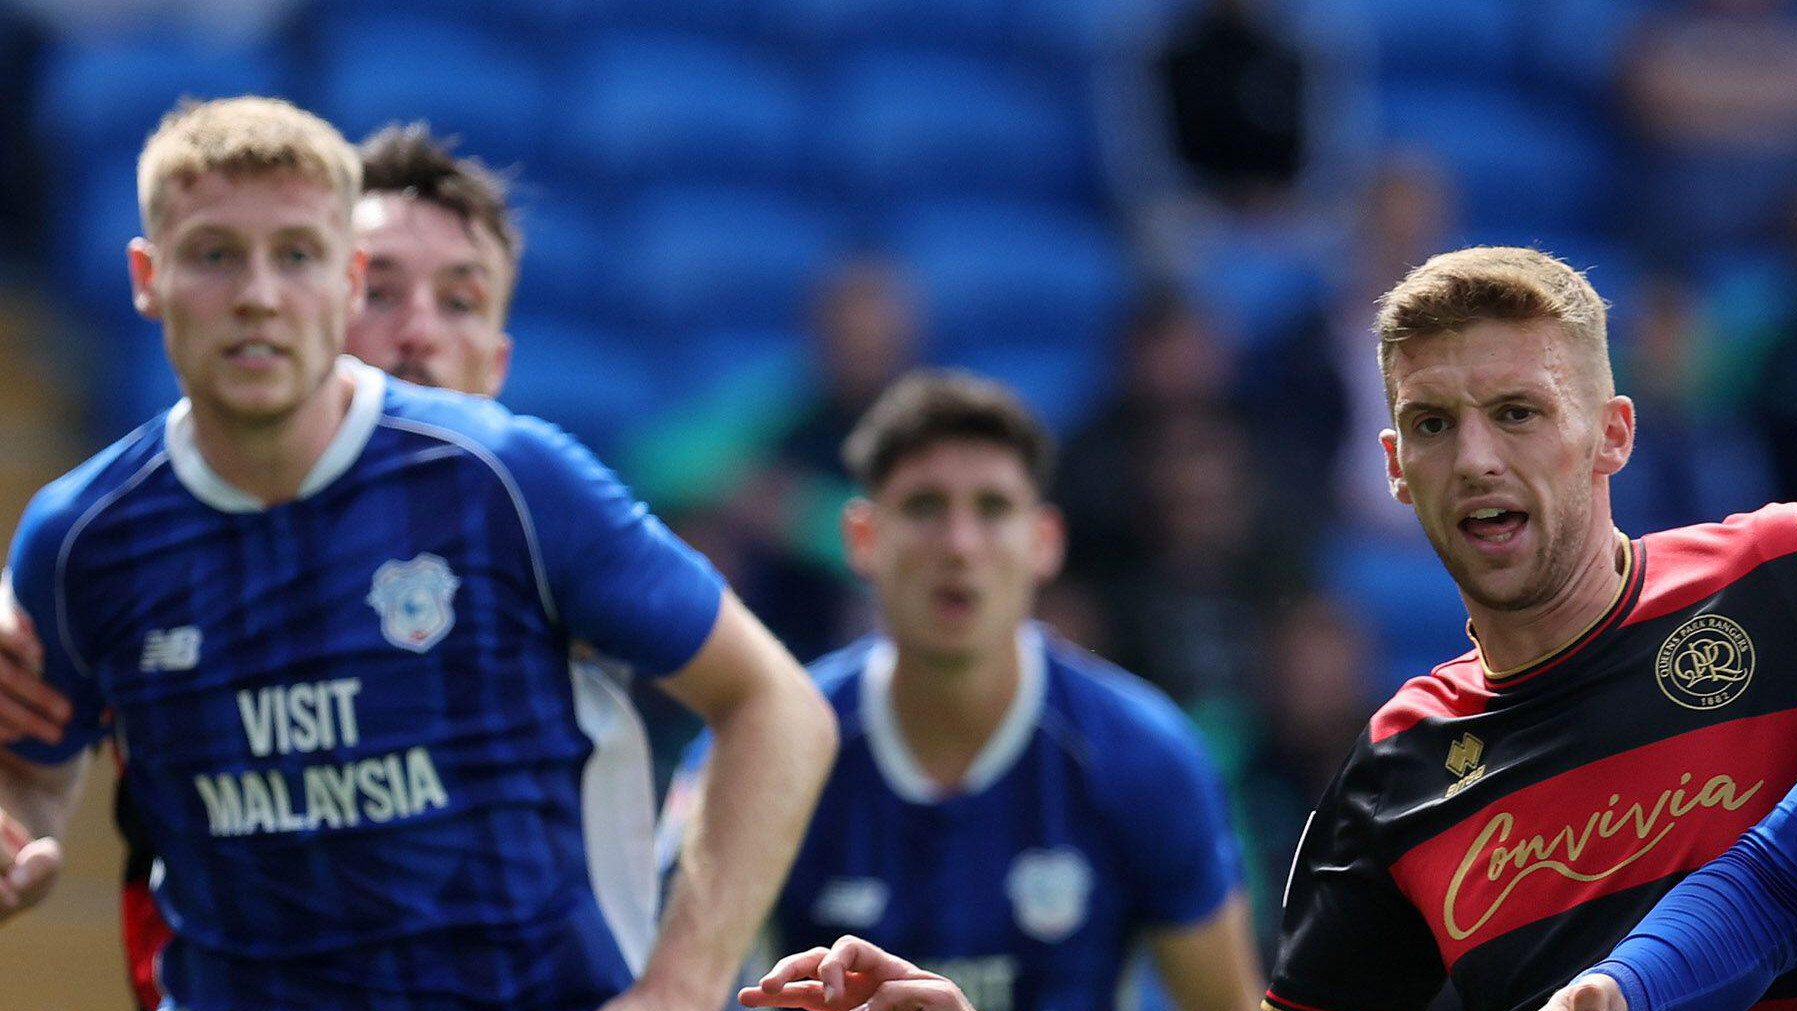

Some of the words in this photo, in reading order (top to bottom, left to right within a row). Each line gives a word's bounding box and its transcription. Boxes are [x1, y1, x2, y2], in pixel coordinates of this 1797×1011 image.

[1680, 619, 1706, 637] PARK
[1708, 618, 1749, 653] RANGERS
[236, 677, 362, 757] VISIT
[193, 746, 449, 837] MALAYSIA
[1443, 772, 1765, 941] Convivia
